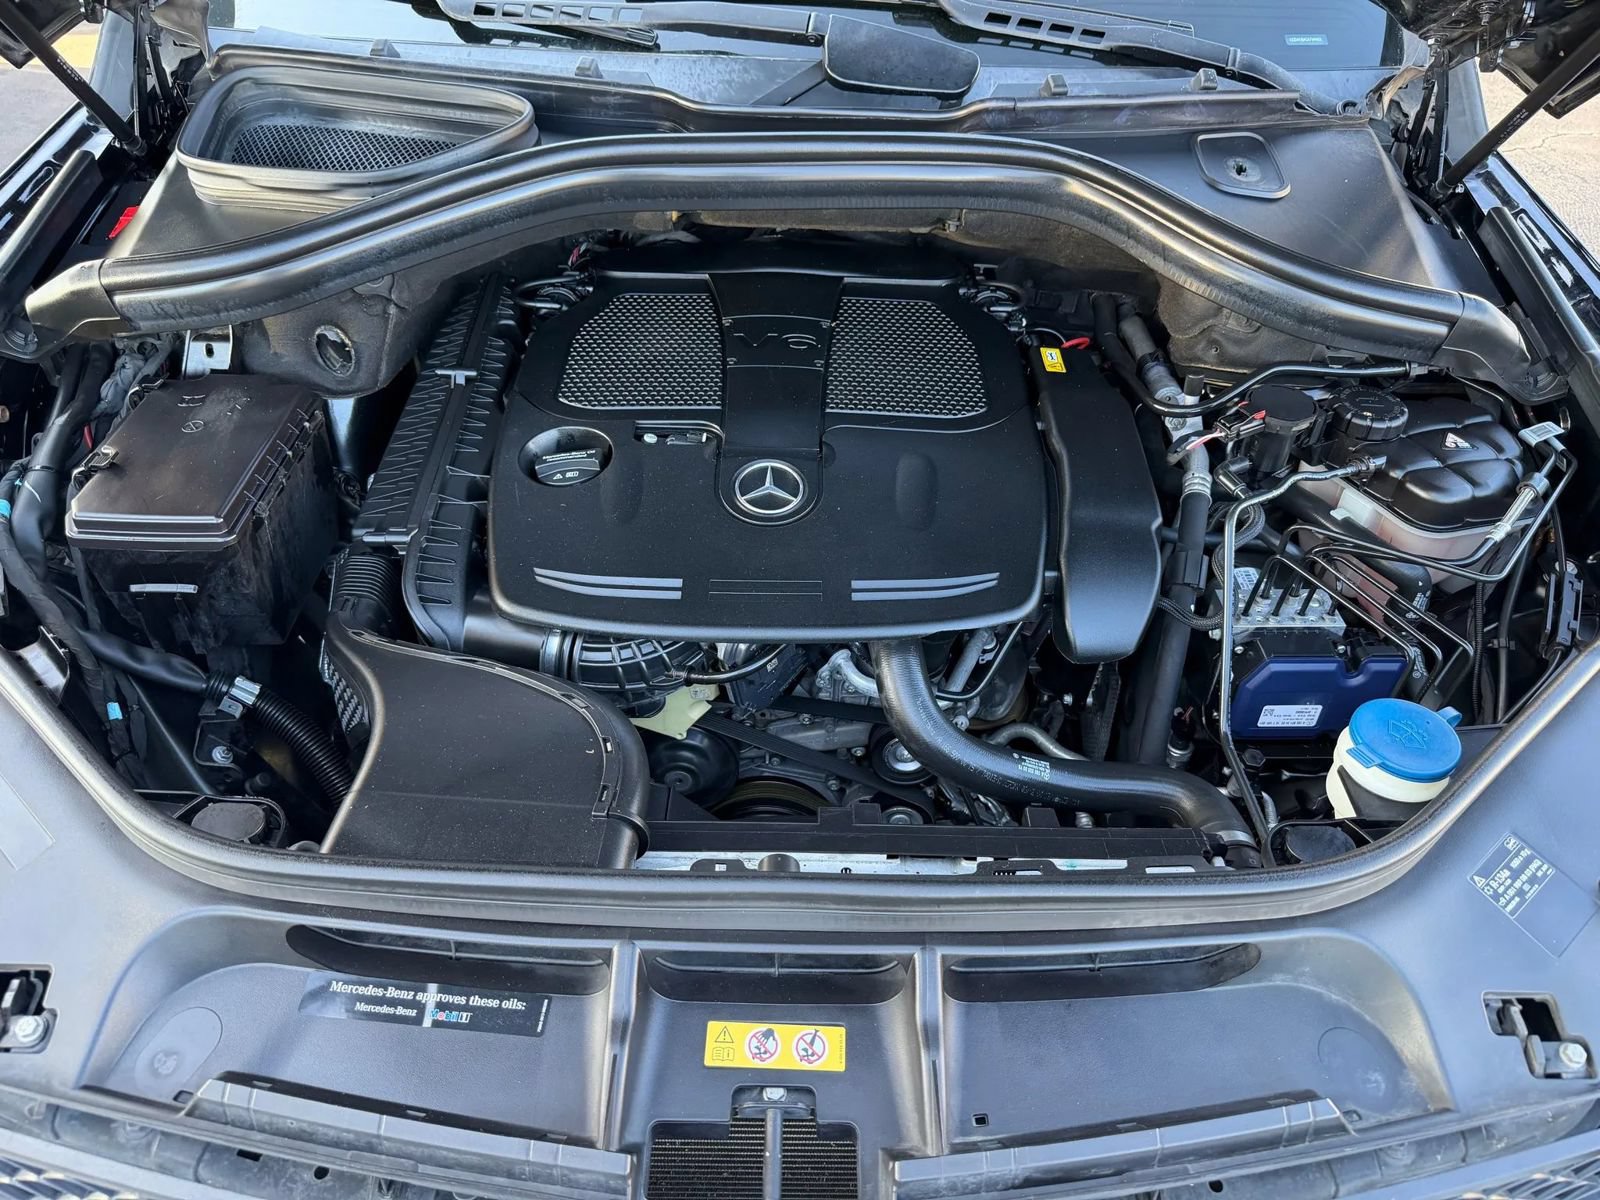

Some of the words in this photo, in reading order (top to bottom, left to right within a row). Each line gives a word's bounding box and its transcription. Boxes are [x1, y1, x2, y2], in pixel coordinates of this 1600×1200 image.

[329, 980, 415, 999] Mercedes-Benz
[415, 992, 467, 1005] approves
[469, 995, 500, 1008] these
[501, 998, 527, 1011] oils:
[354, 1001, 418, 1016] Mercedes-Benz
